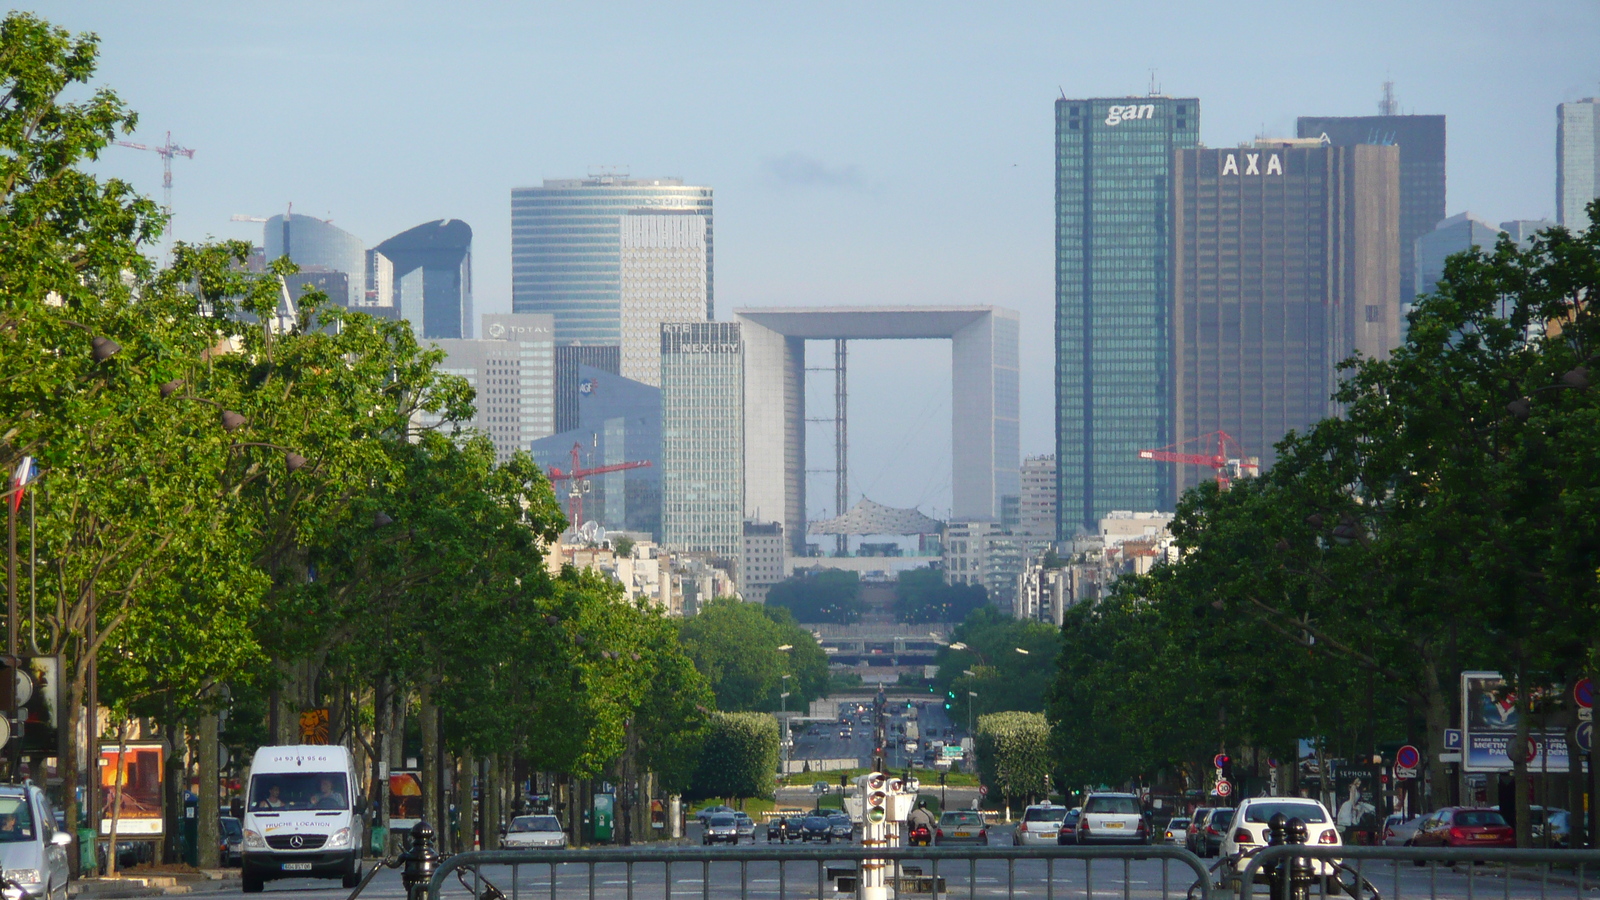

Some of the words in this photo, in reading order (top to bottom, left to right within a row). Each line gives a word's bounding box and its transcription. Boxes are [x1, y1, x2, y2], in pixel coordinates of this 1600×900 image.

[1105, 103, 1154, 126] gan
[1222, 153, 1283, 176] AXA
[510, 325, 550, 333] TOTAL
[663, 323, 691, 333] RTE
[682, 343, 738, 352] NEXITY
[1450, 732, 1459, 745] P
[1489, 748, 1507, 756] PAR
[185, 793, 191, 801] P
